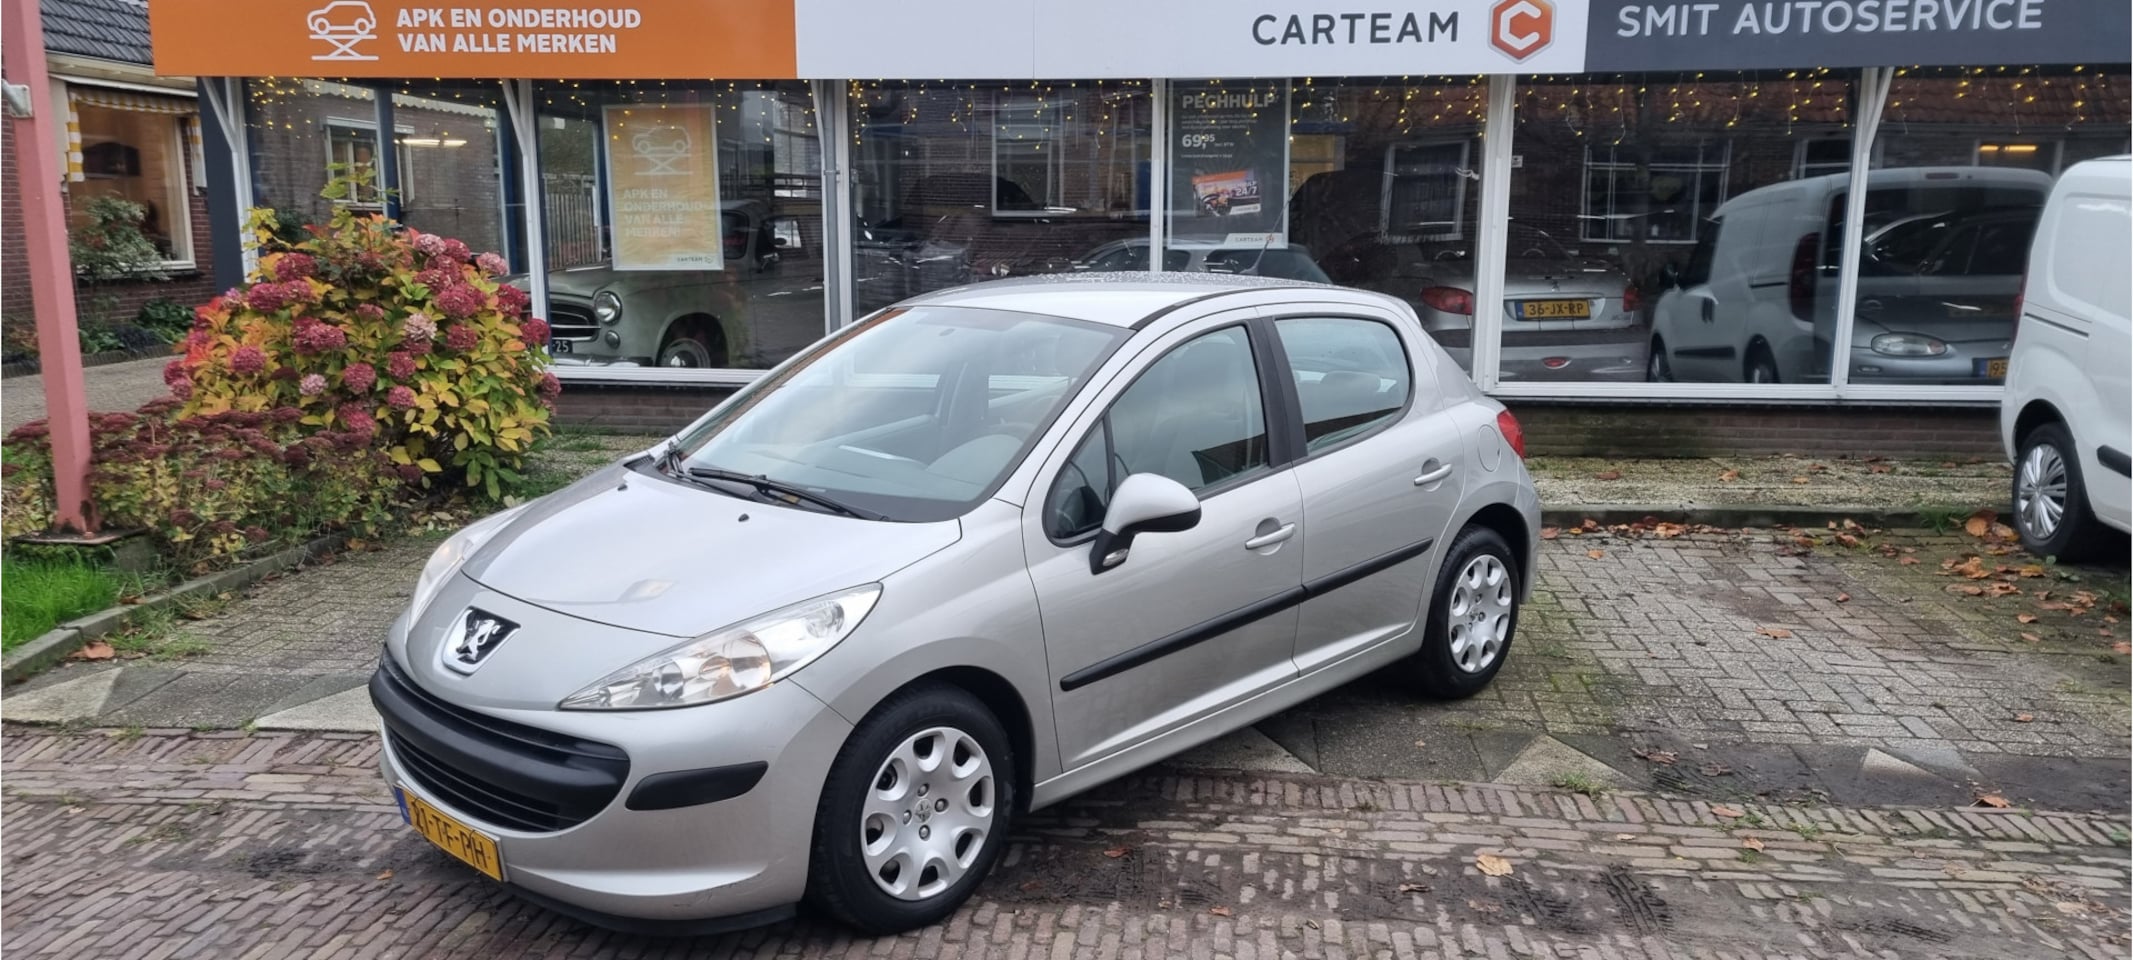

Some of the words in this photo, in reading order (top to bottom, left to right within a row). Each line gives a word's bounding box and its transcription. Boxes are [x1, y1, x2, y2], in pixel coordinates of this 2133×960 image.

[396, 8, 446, 28] APK
[450, 9, 482, 28] EN
[488, 8, 642, 29] ONDERHOUD
[1617, 3, 1719, 37] SMIT
[1733, 0, 2043, 36] AUTOSERVICE
[1252, 11, 1459, 46] CARTEAM
[398, 33, 447, 53] VAN
[453, 33, 511, 53] ALLE
[517, 34, 617, 54] MERKEN
[623, 189, 648, 200] APK
[623, 201, 704, 213] ONDERHOUD
[624, 214, 650, 225] VAN
[1528, 302, 1585, 316] 36-JX-RP
